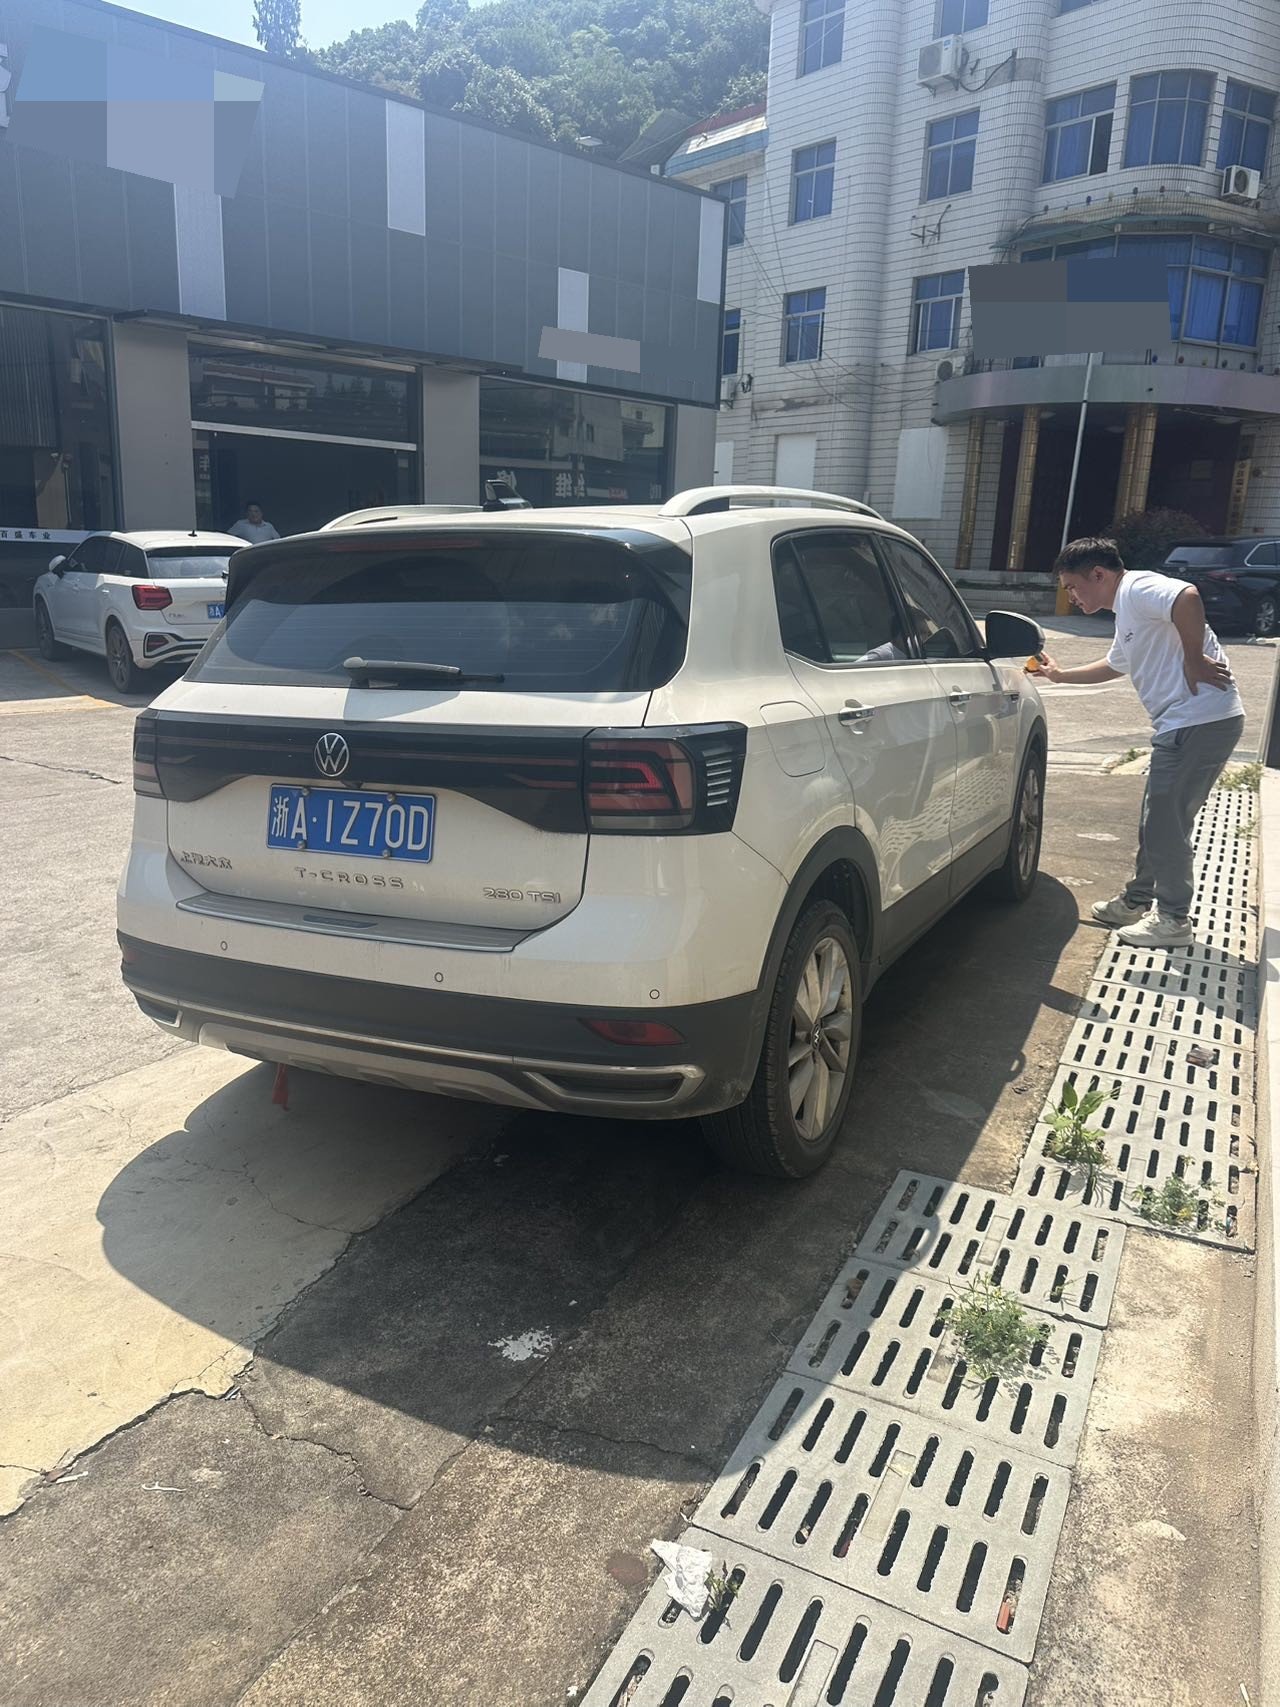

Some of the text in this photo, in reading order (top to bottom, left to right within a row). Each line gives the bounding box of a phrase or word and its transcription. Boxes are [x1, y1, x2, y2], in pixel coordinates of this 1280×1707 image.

[295, 866, 404, 889] T-CROSS
[483, 887, 561, 904] 280 TSI
